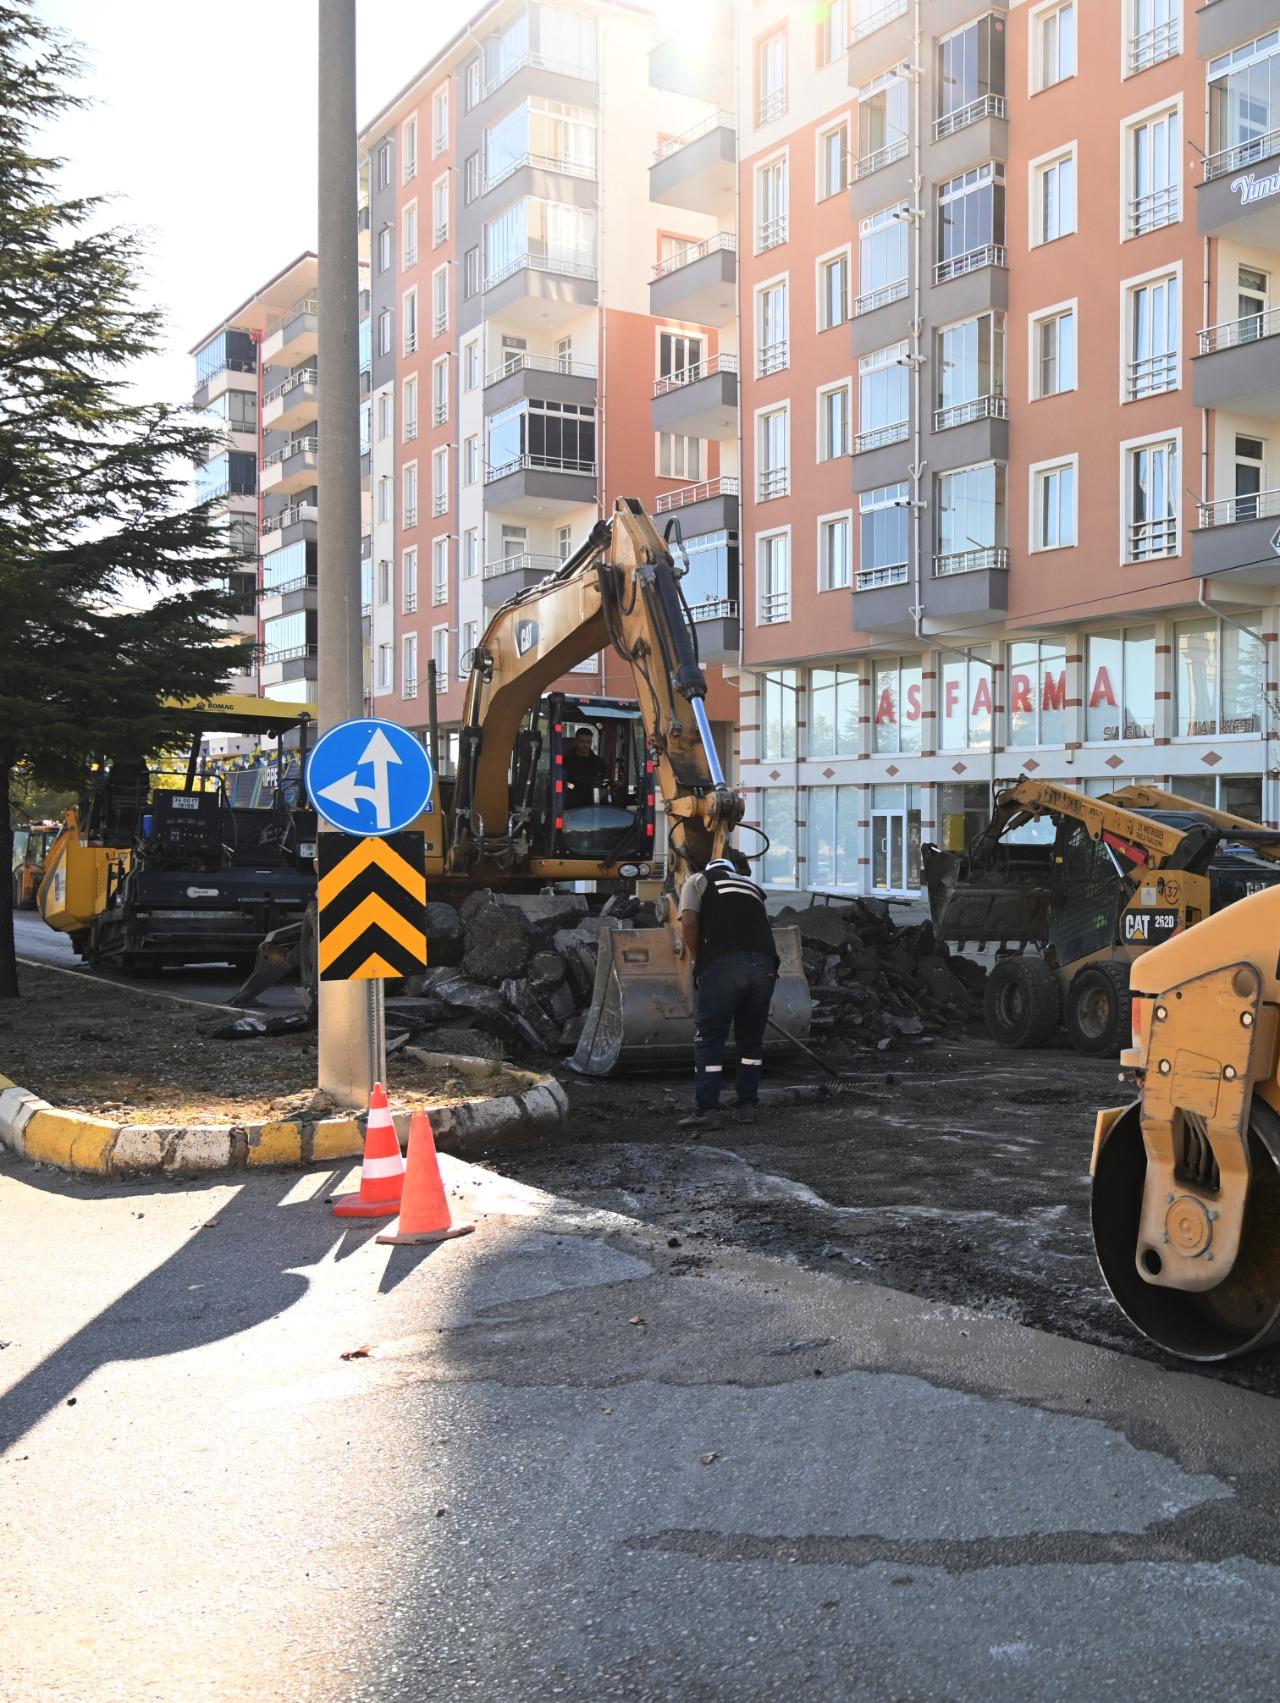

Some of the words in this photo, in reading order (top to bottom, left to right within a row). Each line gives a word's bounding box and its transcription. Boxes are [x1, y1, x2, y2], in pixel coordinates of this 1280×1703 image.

[207, 702, 234, 711] BOMAG
[1166, 885, 1179, 898] 37
[1125, 914, 1150, 940] CAT
[1154, 915, 1175, 928] 262D
